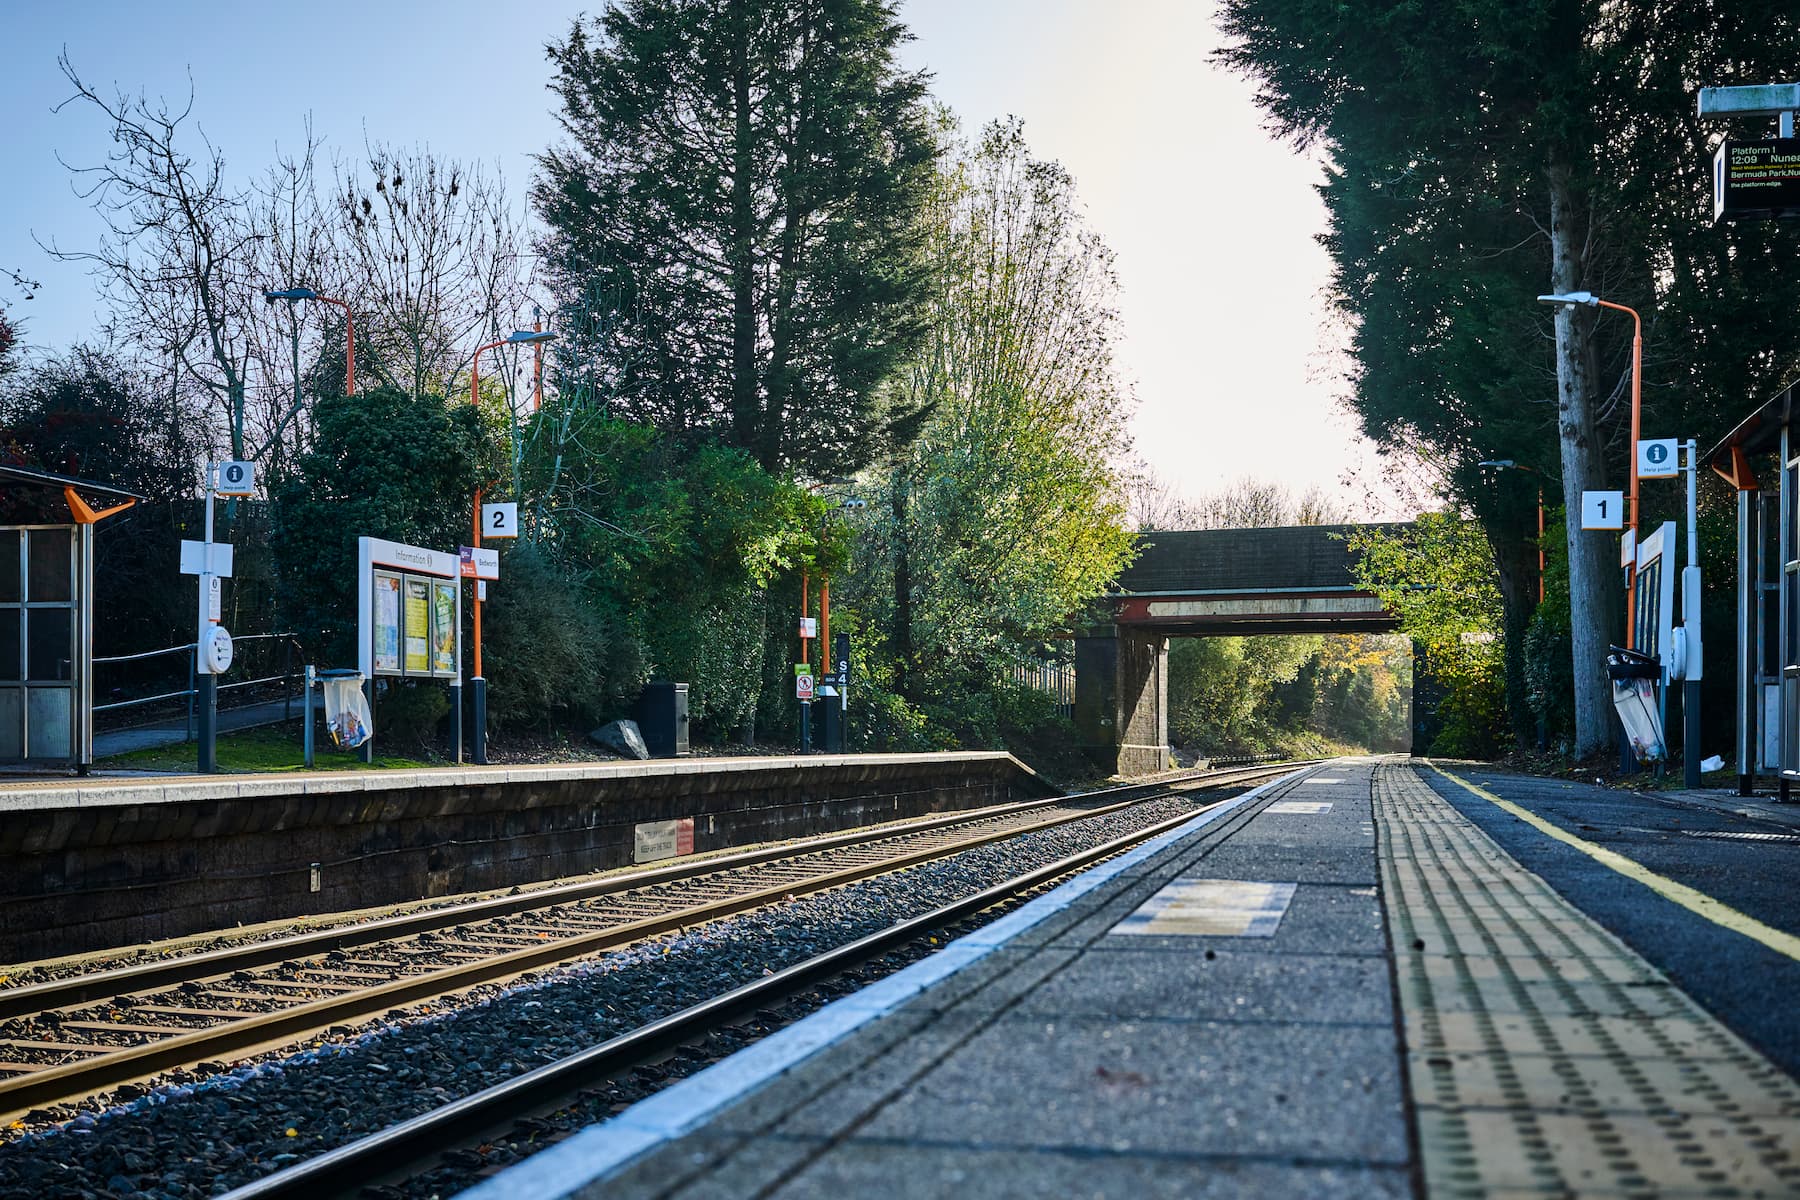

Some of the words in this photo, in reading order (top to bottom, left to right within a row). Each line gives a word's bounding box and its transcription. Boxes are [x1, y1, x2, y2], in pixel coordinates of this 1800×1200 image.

[1731, 155, 1757, 164] 12:09
[1597, 500, 1606, 519] 1
[493, 511, 504, 528] 2
[395, 548, 425, 564] Information
[840, 661, 847, 670] S
[838, 674, 846, 683] 4
